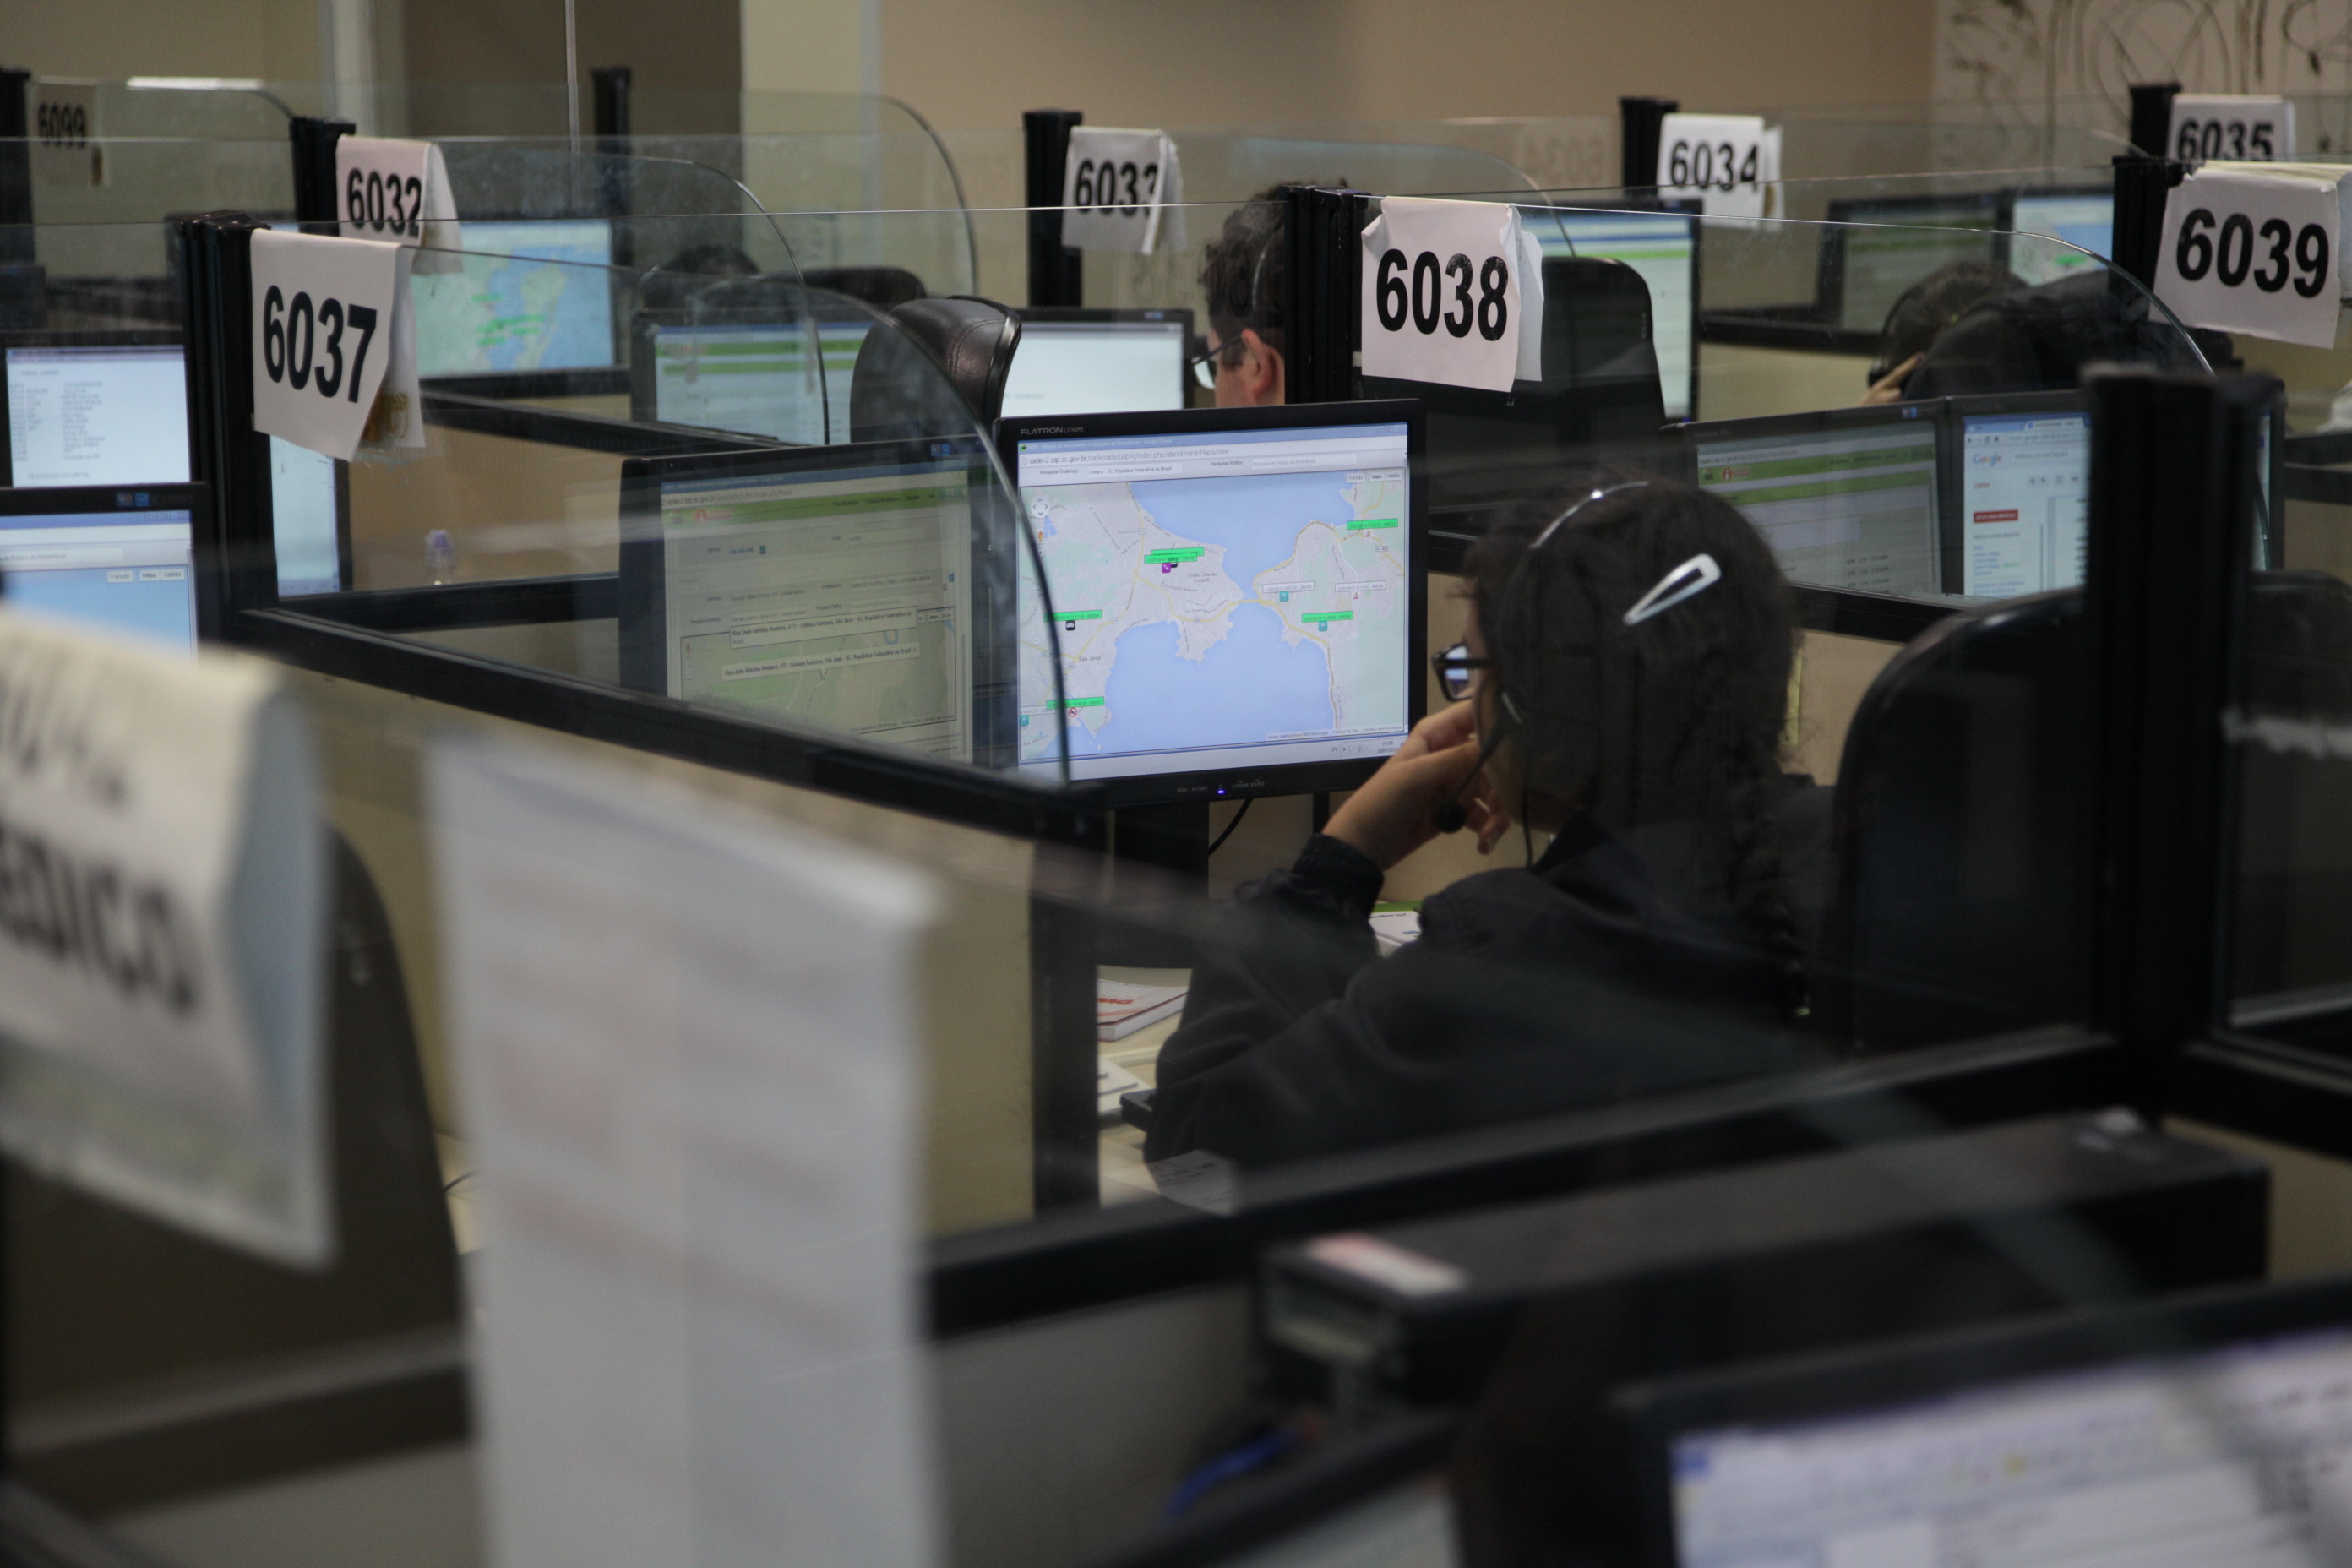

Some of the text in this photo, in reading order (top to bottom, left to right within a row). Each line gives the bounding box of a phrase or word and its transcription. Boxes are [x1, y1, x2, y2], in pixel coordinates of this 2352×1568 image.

[2177, 118, 2274, 161] 6035
[1671, 139, 1757, 193] 6034
[346, 167, 422, 237] 6032
[2176, 208, 2329, 299] 6039
[1376, 248, 1509, 341] 6038
[263, 285, 378, 403] 6037
[1020, 427, 1063, 435] FLATRON
[1973, 453, 2001, 466] Google
[864, 612, 885, 621] República
[853, 651, 873, 660] República
